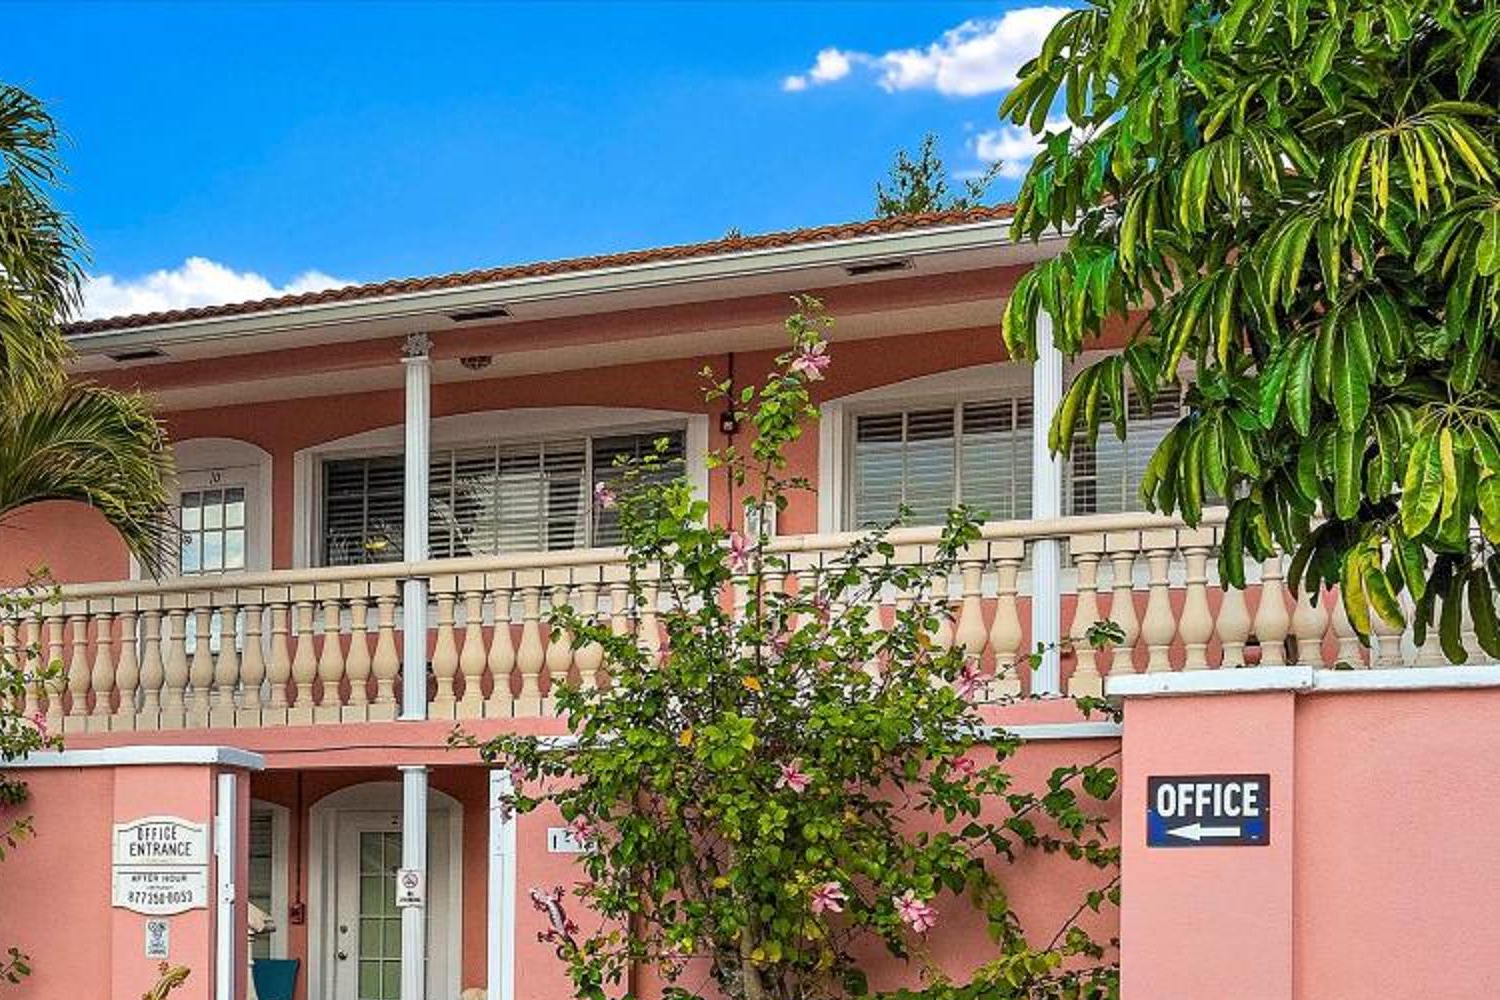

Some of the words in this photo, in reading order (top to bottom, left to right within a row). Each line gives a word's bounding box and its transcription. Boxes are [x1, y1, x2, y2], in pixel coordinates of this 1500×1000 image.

[1157, 782, 1260, 817] OFFICE
[137, 827, 177, 841] OFFICE
[129, 842, 192, 857] ENTRANCE
